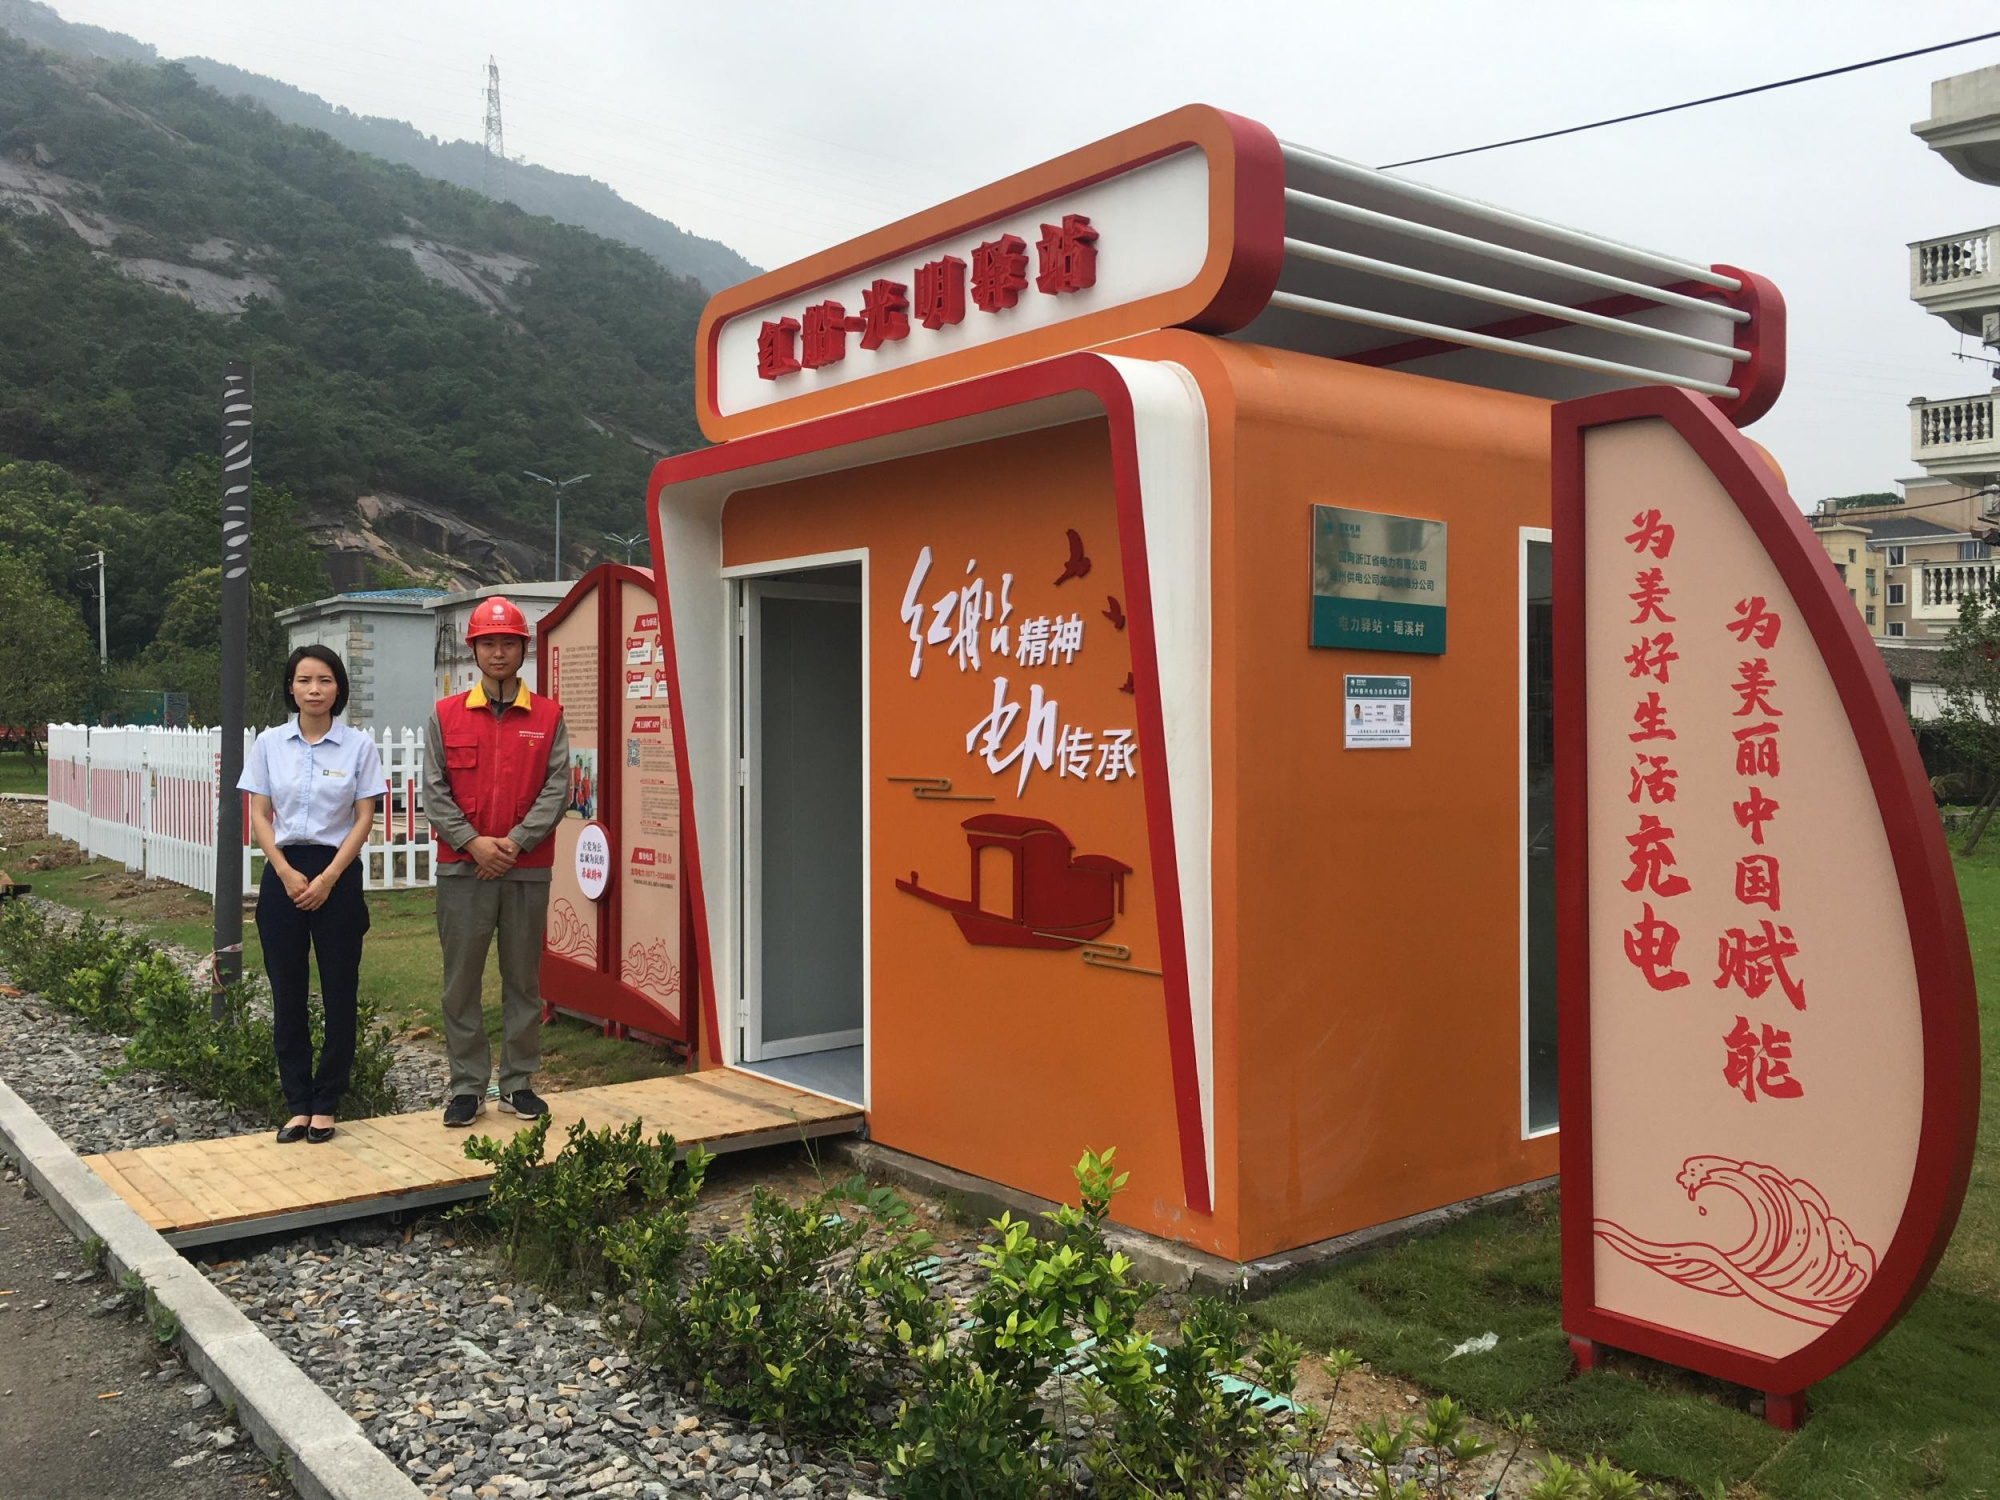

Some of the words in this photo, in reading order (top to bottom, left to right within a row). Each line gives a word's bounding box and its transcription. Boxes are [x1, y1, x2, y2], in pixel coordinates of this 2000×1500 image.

[900, 545, 1086, 680] 红船精神
[1338, 614, 1425, 638] 电力驿站·瑶溪村
[965, 676, 1139, 800] 电力传承
[1620, 508, 1692, 992] 为美好生活充电
[1713, 596, 1807, 1104] 为美丽中国赋能
